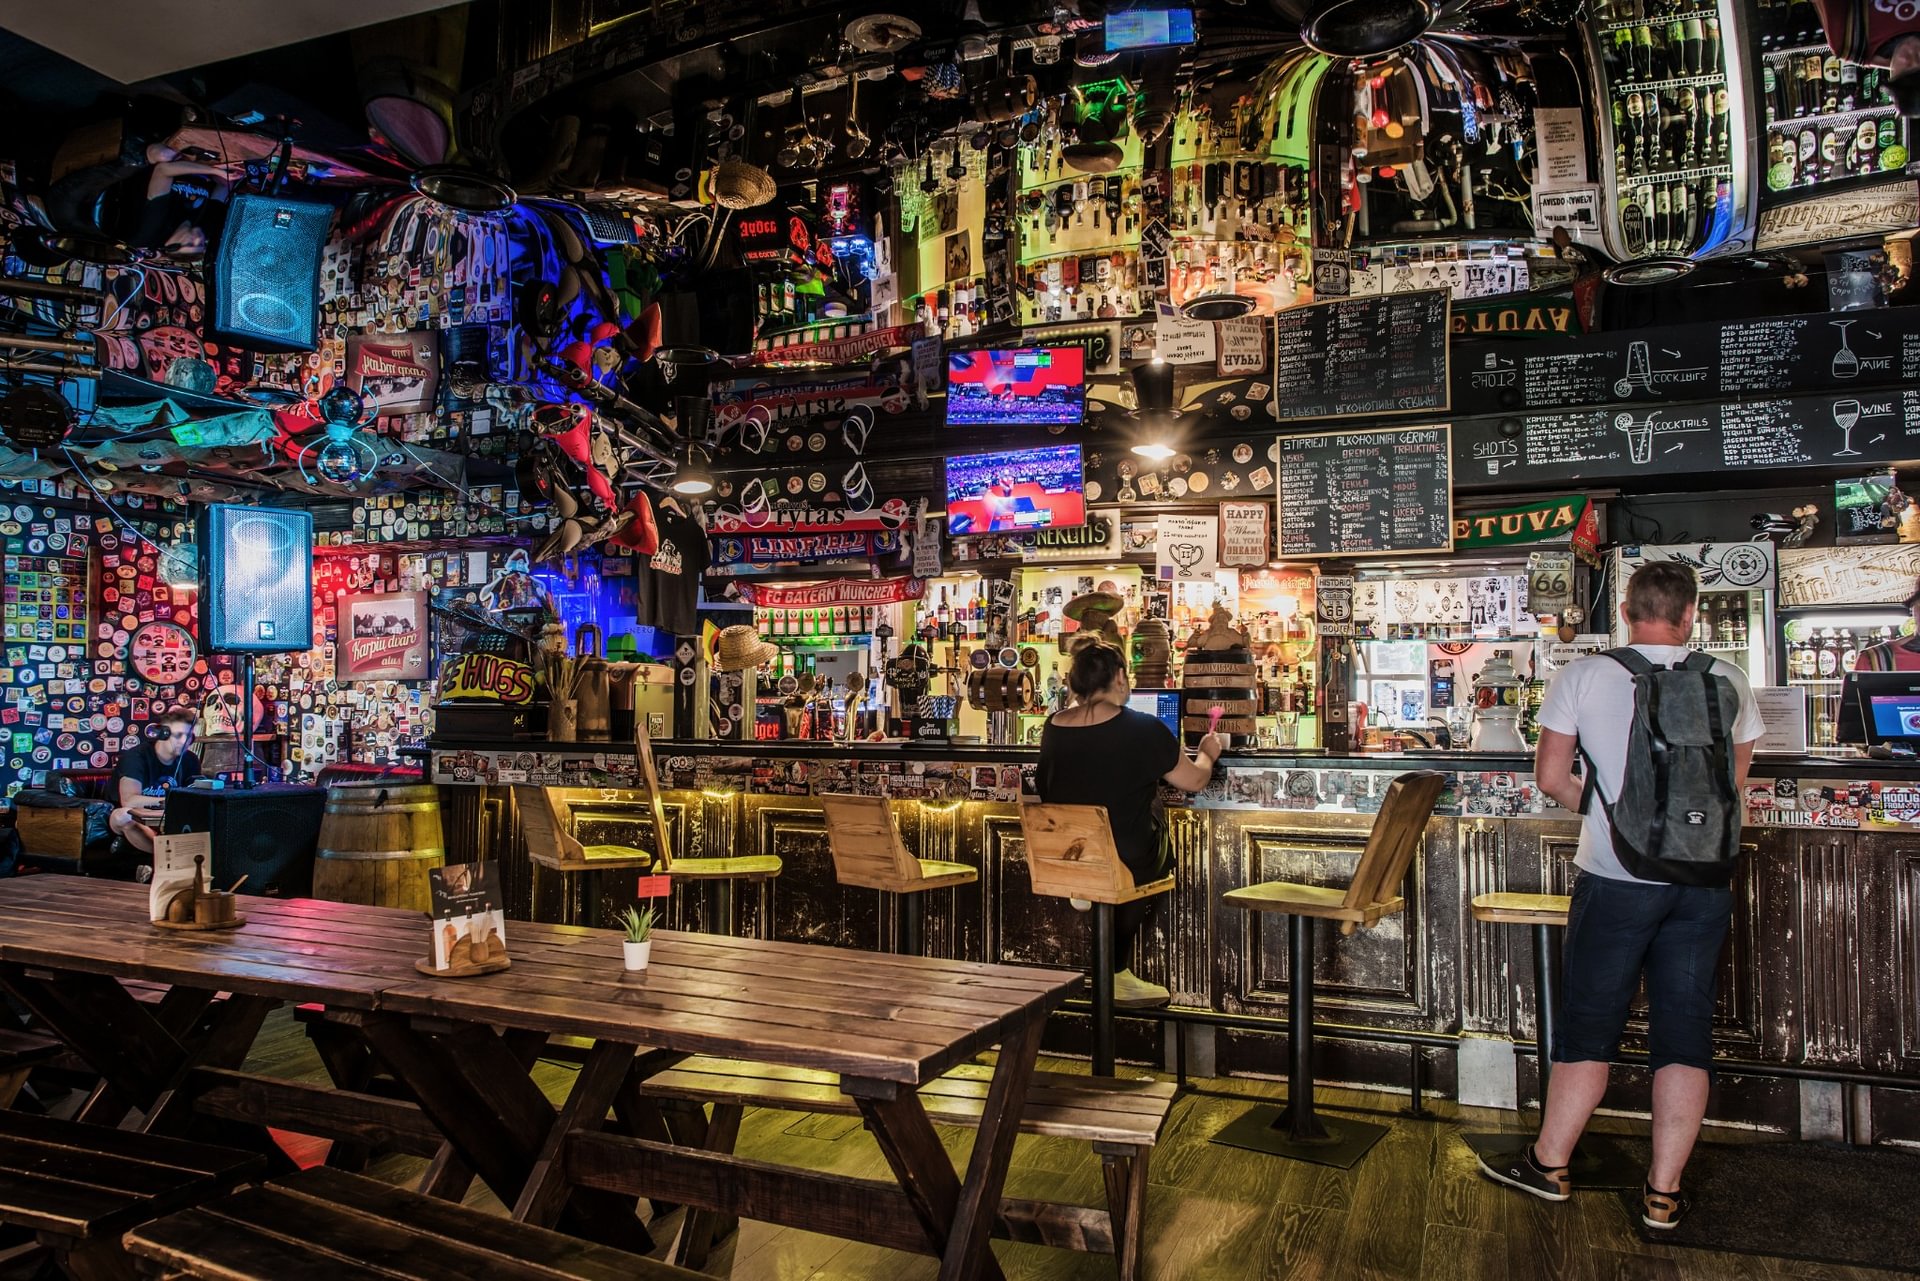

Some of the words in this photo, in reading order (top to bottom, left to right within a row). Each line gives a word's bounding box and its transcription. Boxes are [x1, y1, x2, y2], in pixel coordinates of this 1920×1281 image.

[1747, 401, 1771, 409] LIBRE
[1861, 402, 1893, 415] WINE
[1526, 414, 1564, 424] KAMIKAZE
[1654, 418, 1709, 432] COCKTAILS
[1721, 423, 1752, 431] MALIBU
[1722, 429, 1753, 437] TEQUILA
[1283, 437, 1328, 451] STIPRIEJI
[1336, 432, 1396, 446] ALKOHOLINIAI
[1282, 453, 1305, 463] VISKIS
[1341, 501, 1372, 513] ROMAS
[1392, 506, 1425, 518] LIKERIS
[775, 506, 846, 532] rytas
[1226, 509, 1264, 519] HAPPY
[1233, 525, 1257, 535] When
[751, 531, 867, 555] LINFIELD
[1242, 537, 1263, 545] YOUR
[773, 549, 813, 560] SUPER
[814, 547, 850, 558] BLUES
[1226, 545, 1263, 555] DREAMS
[1319, 578, 1352, 588] HISTORIC
[1535, 573, 1567, 592] 66
[765, 589, 782, 604] FC
[785, 586, 837, 604] BAYERN
[1326, 605, 1343, 617] 66
[1322, 625, 1349, 633] ROUTE
[388, 633, 417, 649] dvaro
[381, 656, 402, 666] alus
[462, 653, 534, 703] HUGS
[1210, 675, 1232, 686] ALUS
[918, 727, 941, 737] Cuervo
[1883, 800, 1905, 809] FROM
[1762, 810, 1813, 825] VILNIUS
[1829, 817, 1859, 827] VILNIUS
